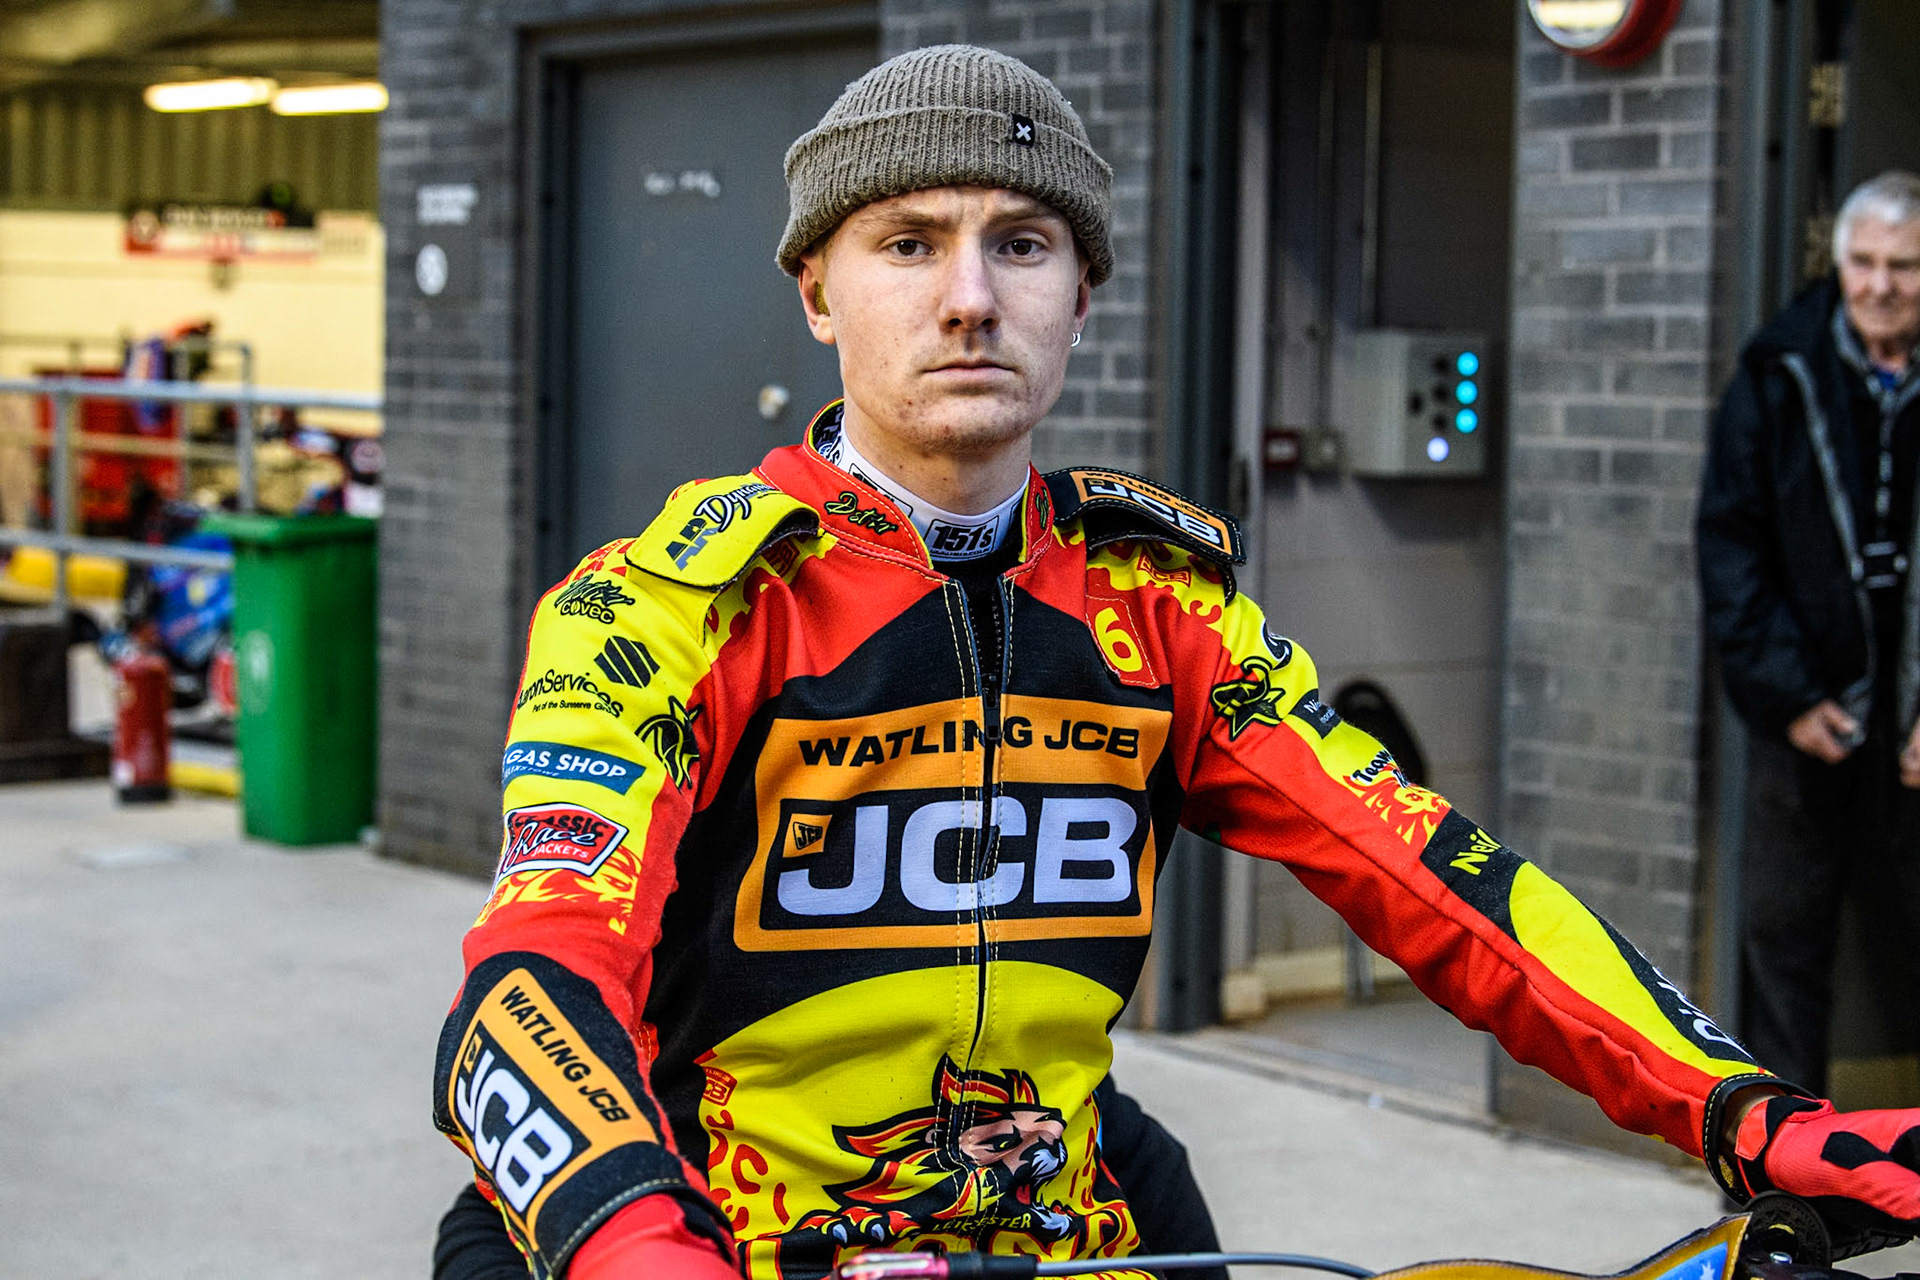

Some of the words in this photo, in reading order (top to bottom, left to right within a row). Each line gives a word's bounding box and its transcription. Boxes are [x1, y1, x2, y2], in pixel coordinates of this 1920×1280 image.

[1091, 483, 1221, 545] JCB
[1095, 607, 1143, 673] 6
[506, 749, 551, 767] GAS
[555, 753, 627, 777] SHOP
[799, 716, 1033, 767] WATLING
[1044, 719, 1139, 759] JCB
[531, 843, 589, 858] JACKETS
[777, 796, 1138, 916] JCB
[1450, 827, 1502, 876] Neil
[500, 986, 591, 1082] WATLING
[578, 1086, 630, 1123] JCB
[456, 1049, 573, 1213] JCB
